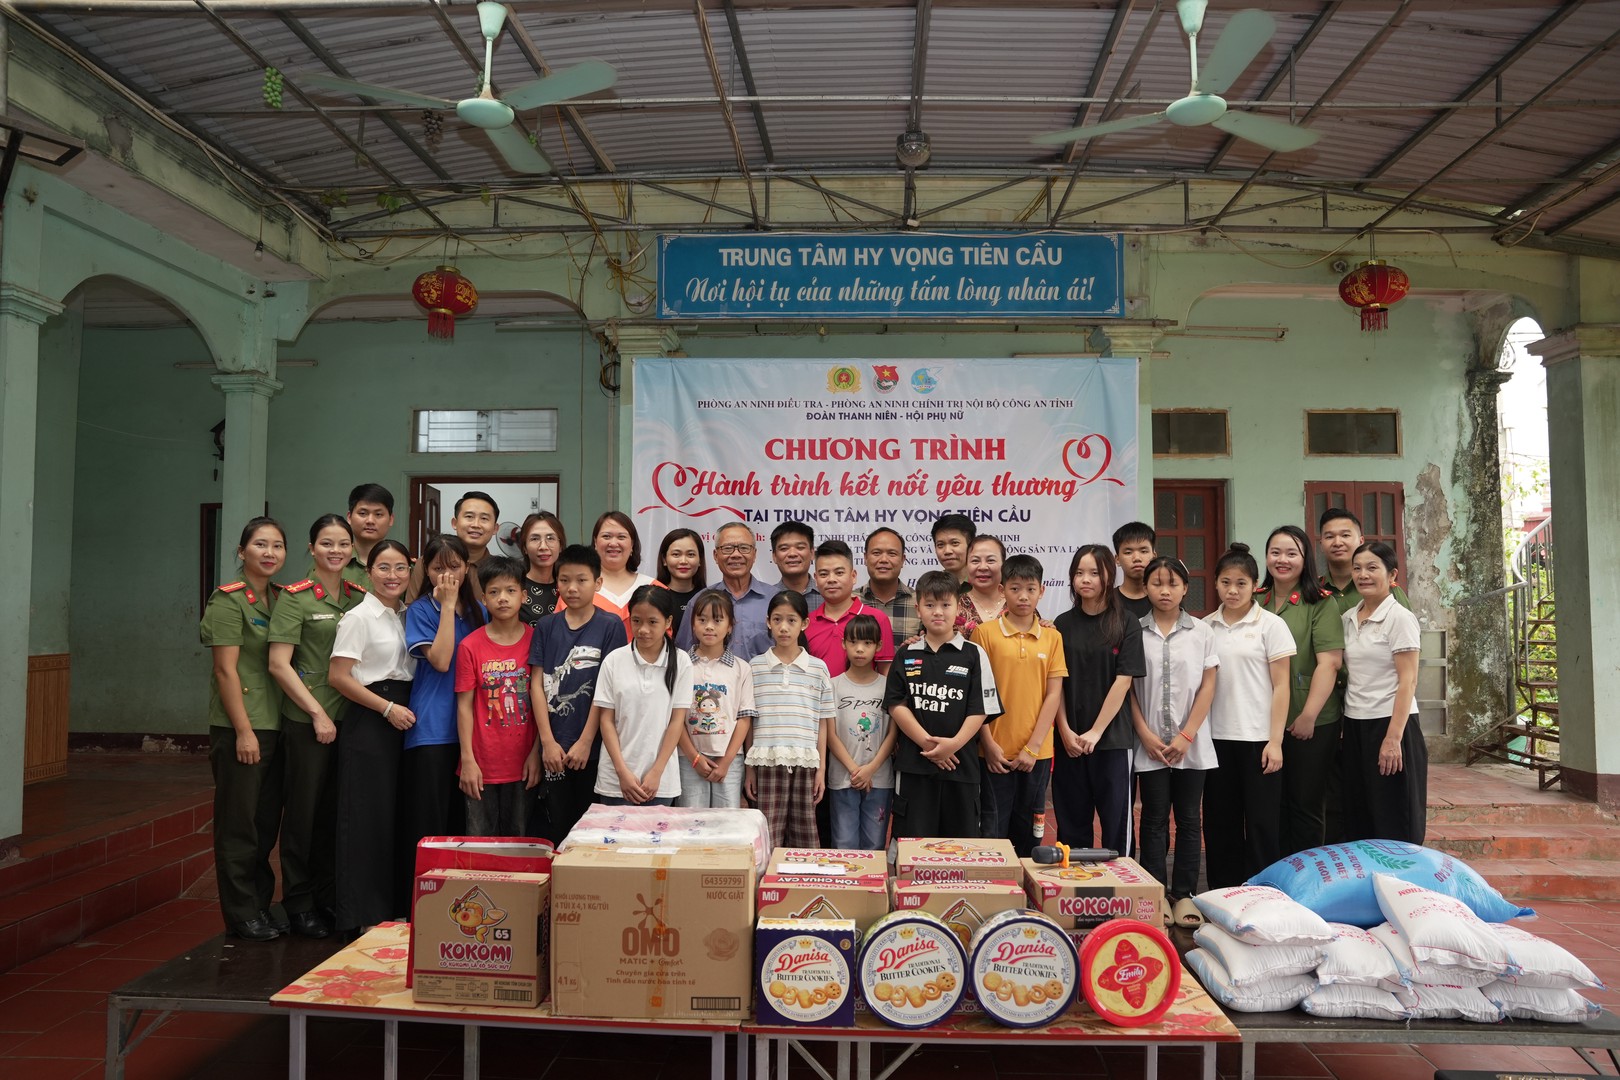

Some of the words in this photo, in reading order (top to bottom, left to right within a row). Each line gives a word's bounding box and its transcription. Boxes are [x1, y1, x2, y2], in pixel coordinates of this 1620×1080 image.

[719, 248, 792, 266] TRUNG
[799, 243, 847, 266] TÂM
[854, 248, 885, 266] HY
[892, 248, 954, 272] VỌNG
[960, 242, 1009, 265] TIÊN
[1016, 238, 1063, 265] CẦU
[685, 277, 725, 303] Nơi
[733, 278, 764, 308] hội
[770, 281, 790, 308] tụ
[797, 277, 831, 302] của
[838, 279, 901, 307] những
[910, 275, 949, 301] tấm
[956, 277, 1002, 307] lòng
[1008, 277, 1061, 301] nhân
[1067, 277, 1096, 300] ái!
[698, 399, 732, 408] PHÒNG
[734, 400, 748, 408] AN
[750, 400, 775, 408] NINH
[777, 398, 800, 408] ĐIỀU
[804, 400, 823, 408] TRA
[831, 399, 865, 408] PHÒNG
[869, 400, 882, 408] AN
[885, 400, 909, 408] NINH
[912, 399, 944, 408] CHÍNH
[946, 400, 963, 409] TRỊ
[966, 398, 983, 409] NỘI
[986, 398, 1000, 409] BỘ
[1002, 399, 1030, 408] CÔNG
[1034, 400, 1047, 408] AN
[1050, 398, 1073, 408] TỈNH
[806, 410, 835, 420] ĐOÀN
[839, 412, 872, 420] THANH
[875, 410, 897, 420] NIÊN
[906, 410, 924, 422] HỘI
[927, 412, 946, 422] PHỤ
[950, 410, 965, 420] NỮ
[765, 437, 900, 461] CHƯƠNG
[911, 432, 1006, 460] TRÌNH
[691, 468, 765, 497] Hành
[770, 470, 834, 497] trình
[839, 467, 880, 497] kết
[887, 467, 927, 497] nối
[936, 473, 982, 503] yêu
[991, 474, 1080, 502] thương
[744, 509, 768, 526] TẠI
[774, 509, 829, 522] TRUNG
[835, 507, 869, 522] TÂM
[875, 509, 898, 522] HY
[902, 509, 952, 524] VỌNG
[998, 504, 1031, 522] CẦU
[847, 533, 870, 541] PHÁ
[905, 533, 932, 542] CÔNG
[1006, 545, 1026, 555] ỘNG
[909, 682, 964, 700] Bridges
[984, 688, 996, 697] 97
[914, 696, 949, 712] Bear
[704, 877, 742, 885] 64359799
[914, 869, 964, 880] KOKOMI
[707, 891, 727, 900] NƯỚC
[729, 891, 744, 902] GIẶT
[762, 890, 779, 901] MỚI
[903, 895, 920, 906] MỚI
[1060, 897, 1132, 916] KOKOMI
[555, 911, 582, 923] MỚI
[495, 930, 509, 939] 65
[622, 927, 680, 957] OMO
[439, 942, 513, 963] KOKOMI
[876, 936, 939, 973] Danisa
[991, 939, 1057, 964] Danisa
[774, 948, 830, 973] Danisa
[908, 959, 941, 968] TRADITIONAL
[1022, 962, 1054, 970] TRADITIONAL
[777, 973, 803, 981] BUTTER
[804, 974, 835, 982] COOKIES
[880, 970, 911, 981] BUTTER
[911, 964, 946, 976] COOKIES
[993, 963, 1023, 975] BUTTER
[1023, 967, 1057, 979] COOKIES
[1119, 967, 1143, 981] Emily
